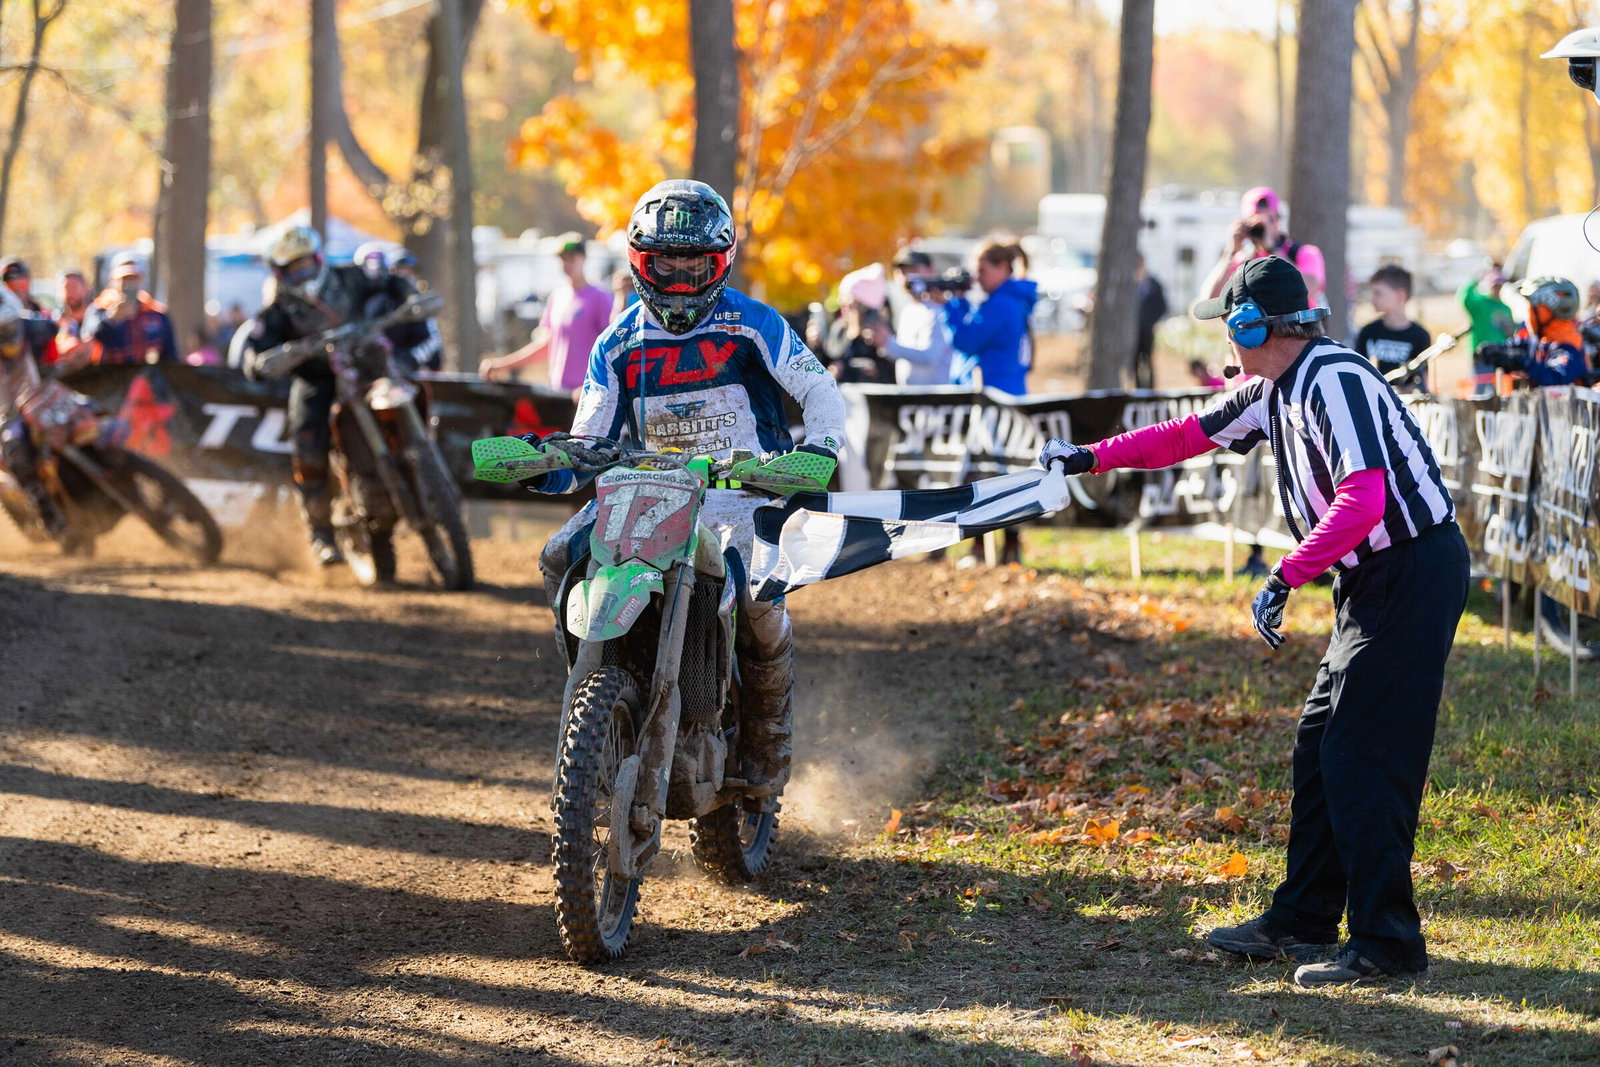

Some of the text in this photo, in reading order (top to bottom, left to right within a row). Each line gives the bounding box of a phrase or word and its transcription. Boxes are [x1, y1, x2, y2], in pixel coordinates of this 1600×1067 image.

[714, 311, 741, 321] WPS
[626, 340, 740, 389] FLY
[614, 473, 695, 487] GNCCRACING.co
[603, 484, 692, 541] 17
